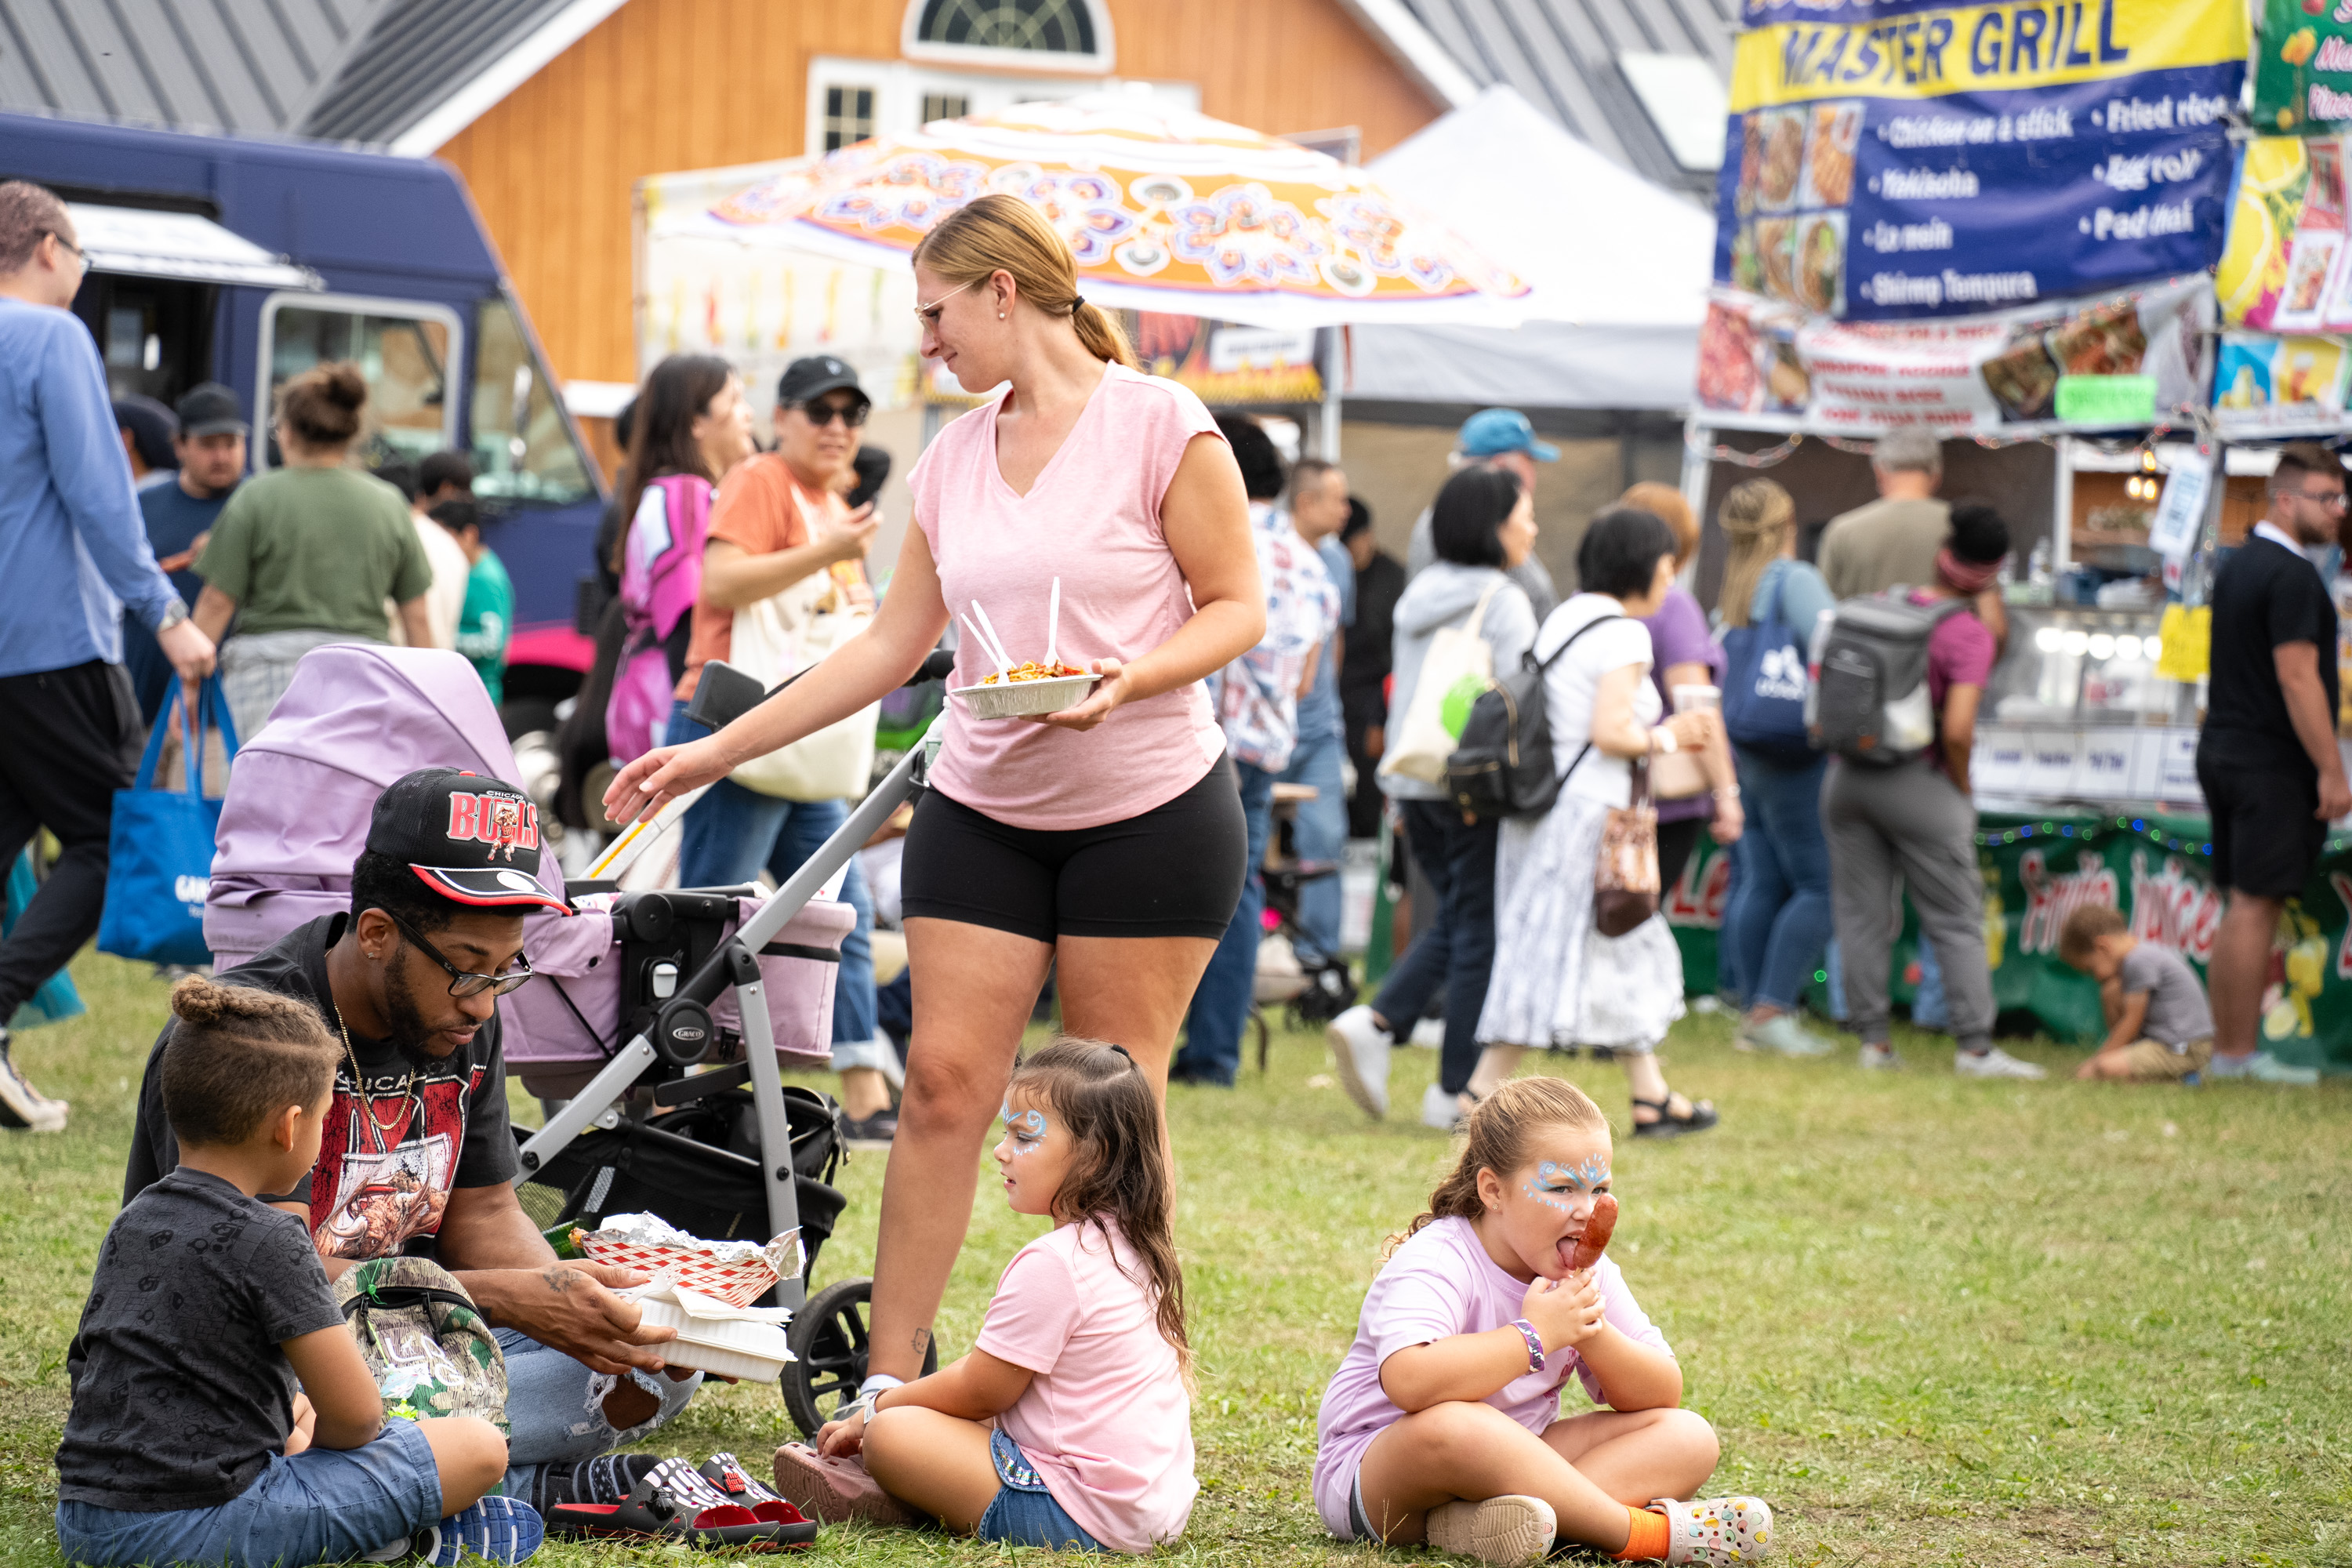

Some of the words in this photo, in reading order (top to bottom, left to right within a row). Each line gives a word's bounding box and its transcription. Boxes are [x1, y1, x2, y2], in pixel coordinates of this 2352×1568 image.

[1781, 17, 1953, 88] MASTER
[1971, 0, 2129, 76] GRILL
[2107, 94, 2173, 133] Fried
[2094, 205, 2149, 241] Pad
[2147, 198, 2194, 236] thai
[486, 790, 524, 800] CHICAGO
[446, 791, 539, 851] BULS
[677, 1029, 703, 1038] GRACO
